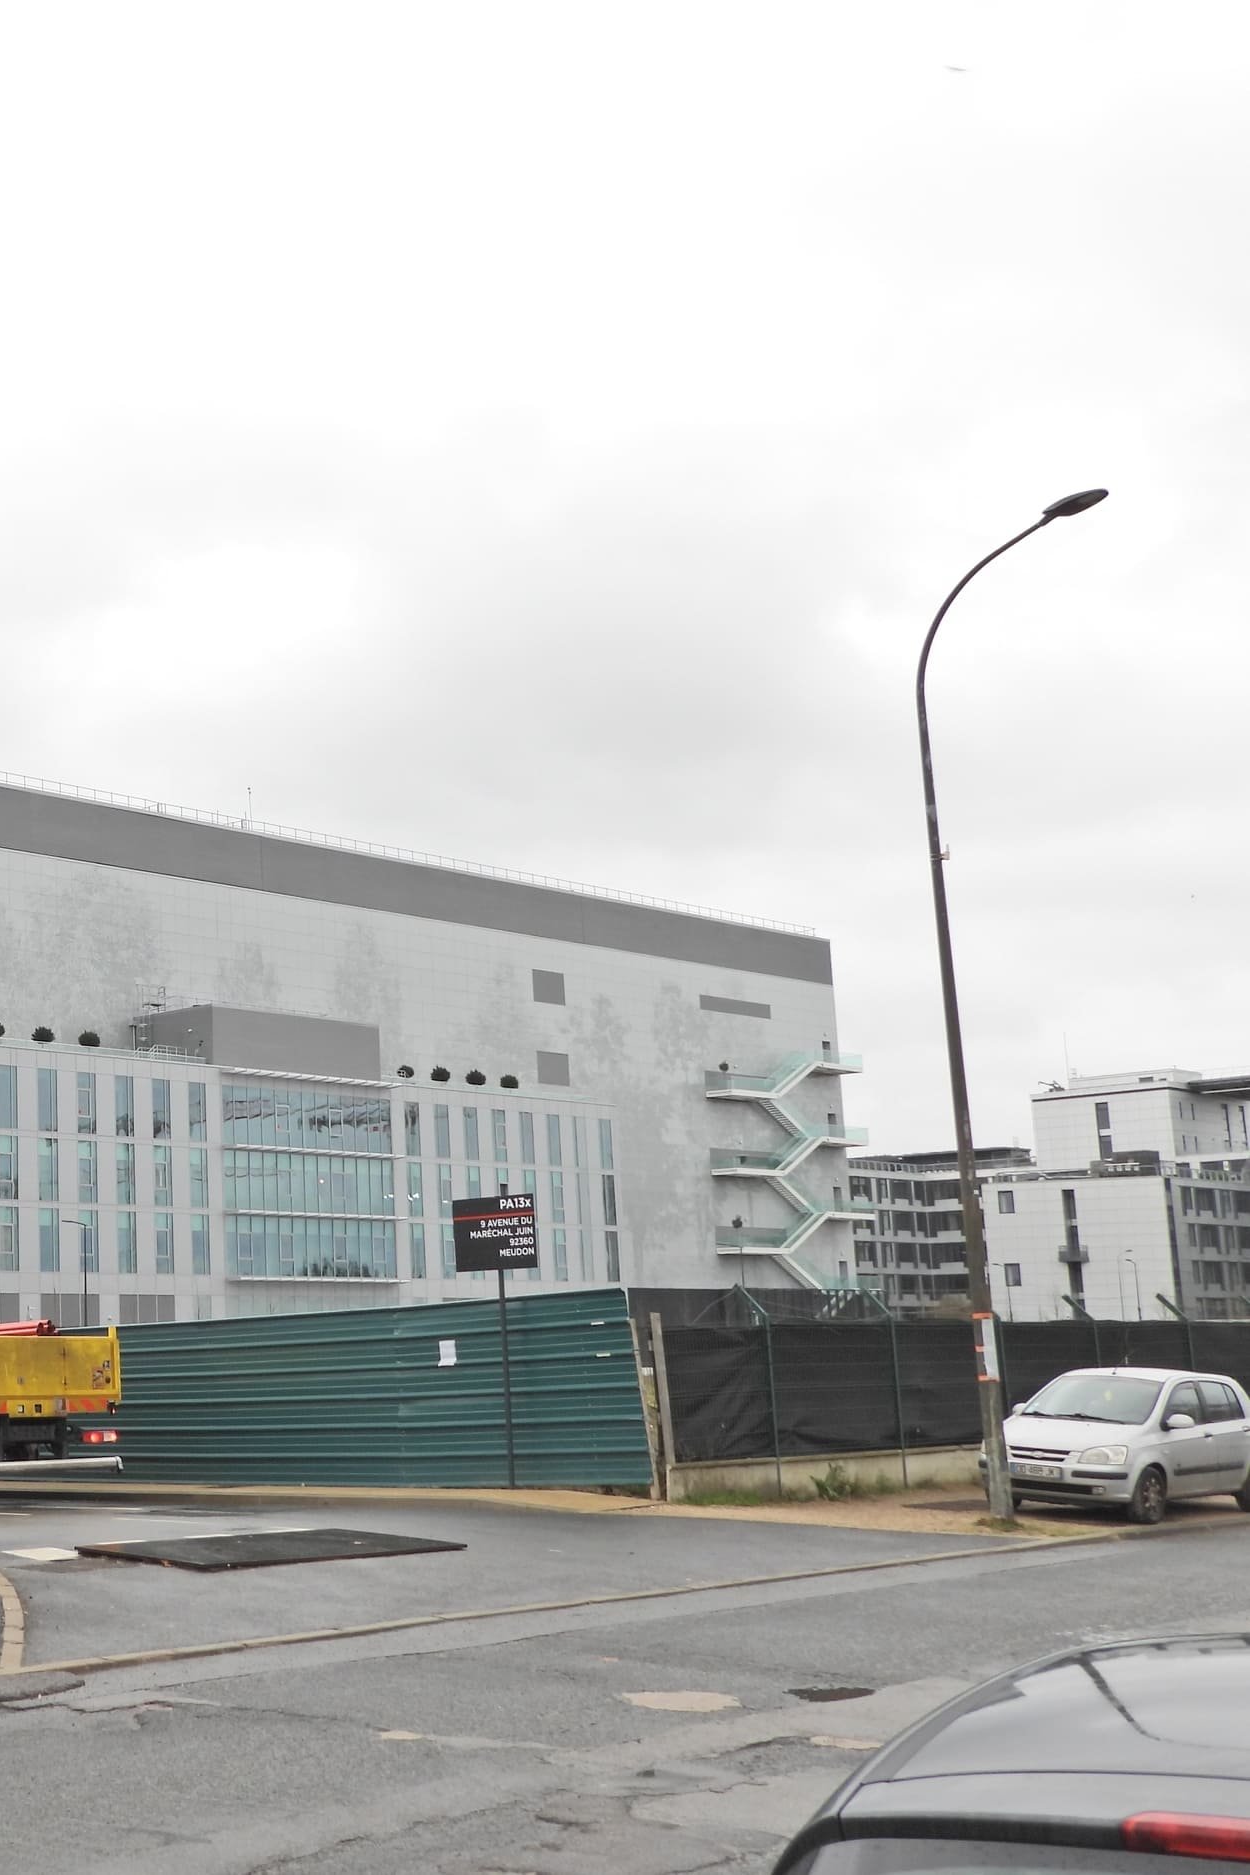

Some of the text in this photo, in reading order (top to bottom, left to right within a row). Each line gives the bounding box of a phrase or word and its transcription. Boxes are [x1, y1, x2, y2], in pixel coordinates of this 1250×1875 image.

[480, 1216, 532, 1228] 9 AVENUE DU
[470, 1227, 533, 1239] MARÉCHAL JUIN
[510, 1237, 534, 1246] 92360
[500, 1247, 535, 1257] MEUDON
